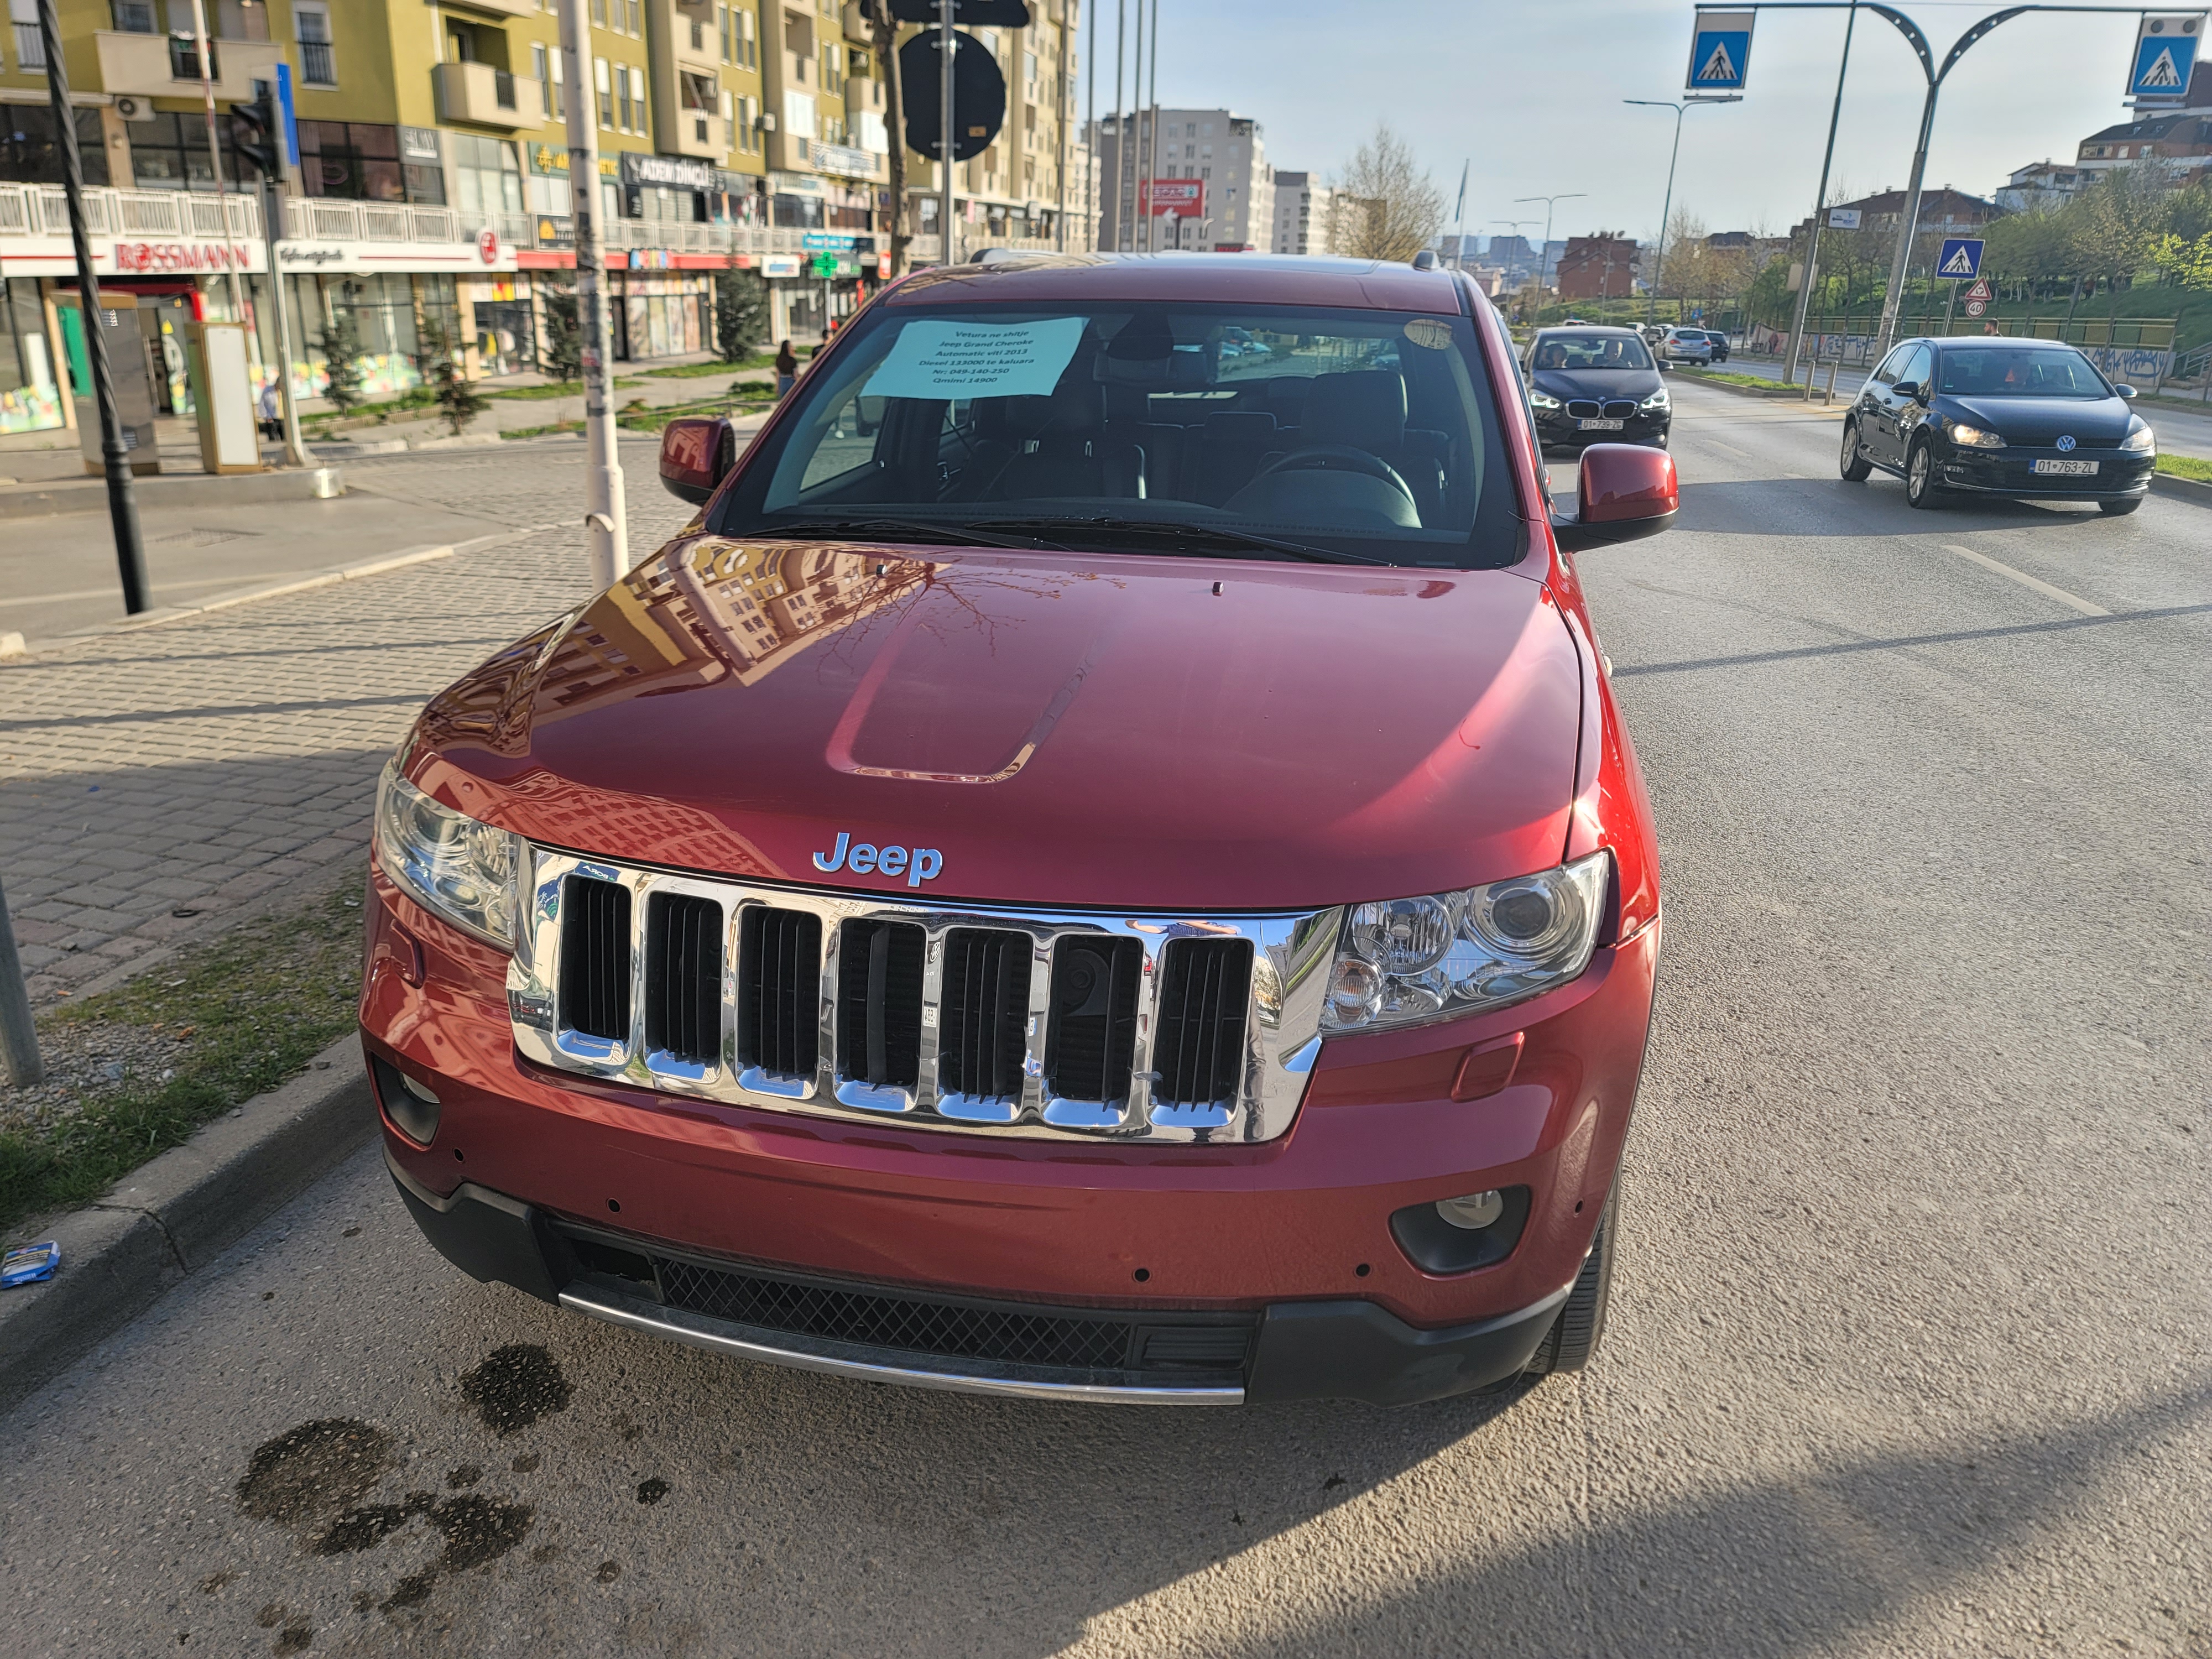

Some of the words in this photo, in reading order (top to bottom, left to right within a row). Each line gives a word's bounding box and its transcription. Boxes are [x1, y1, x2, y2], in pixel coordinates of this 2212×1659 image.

[115, 243, 250, 272] ROSSMANN
[1970, 304, 1982, 312] 40
[812, 832, 943, 888] Jeep
